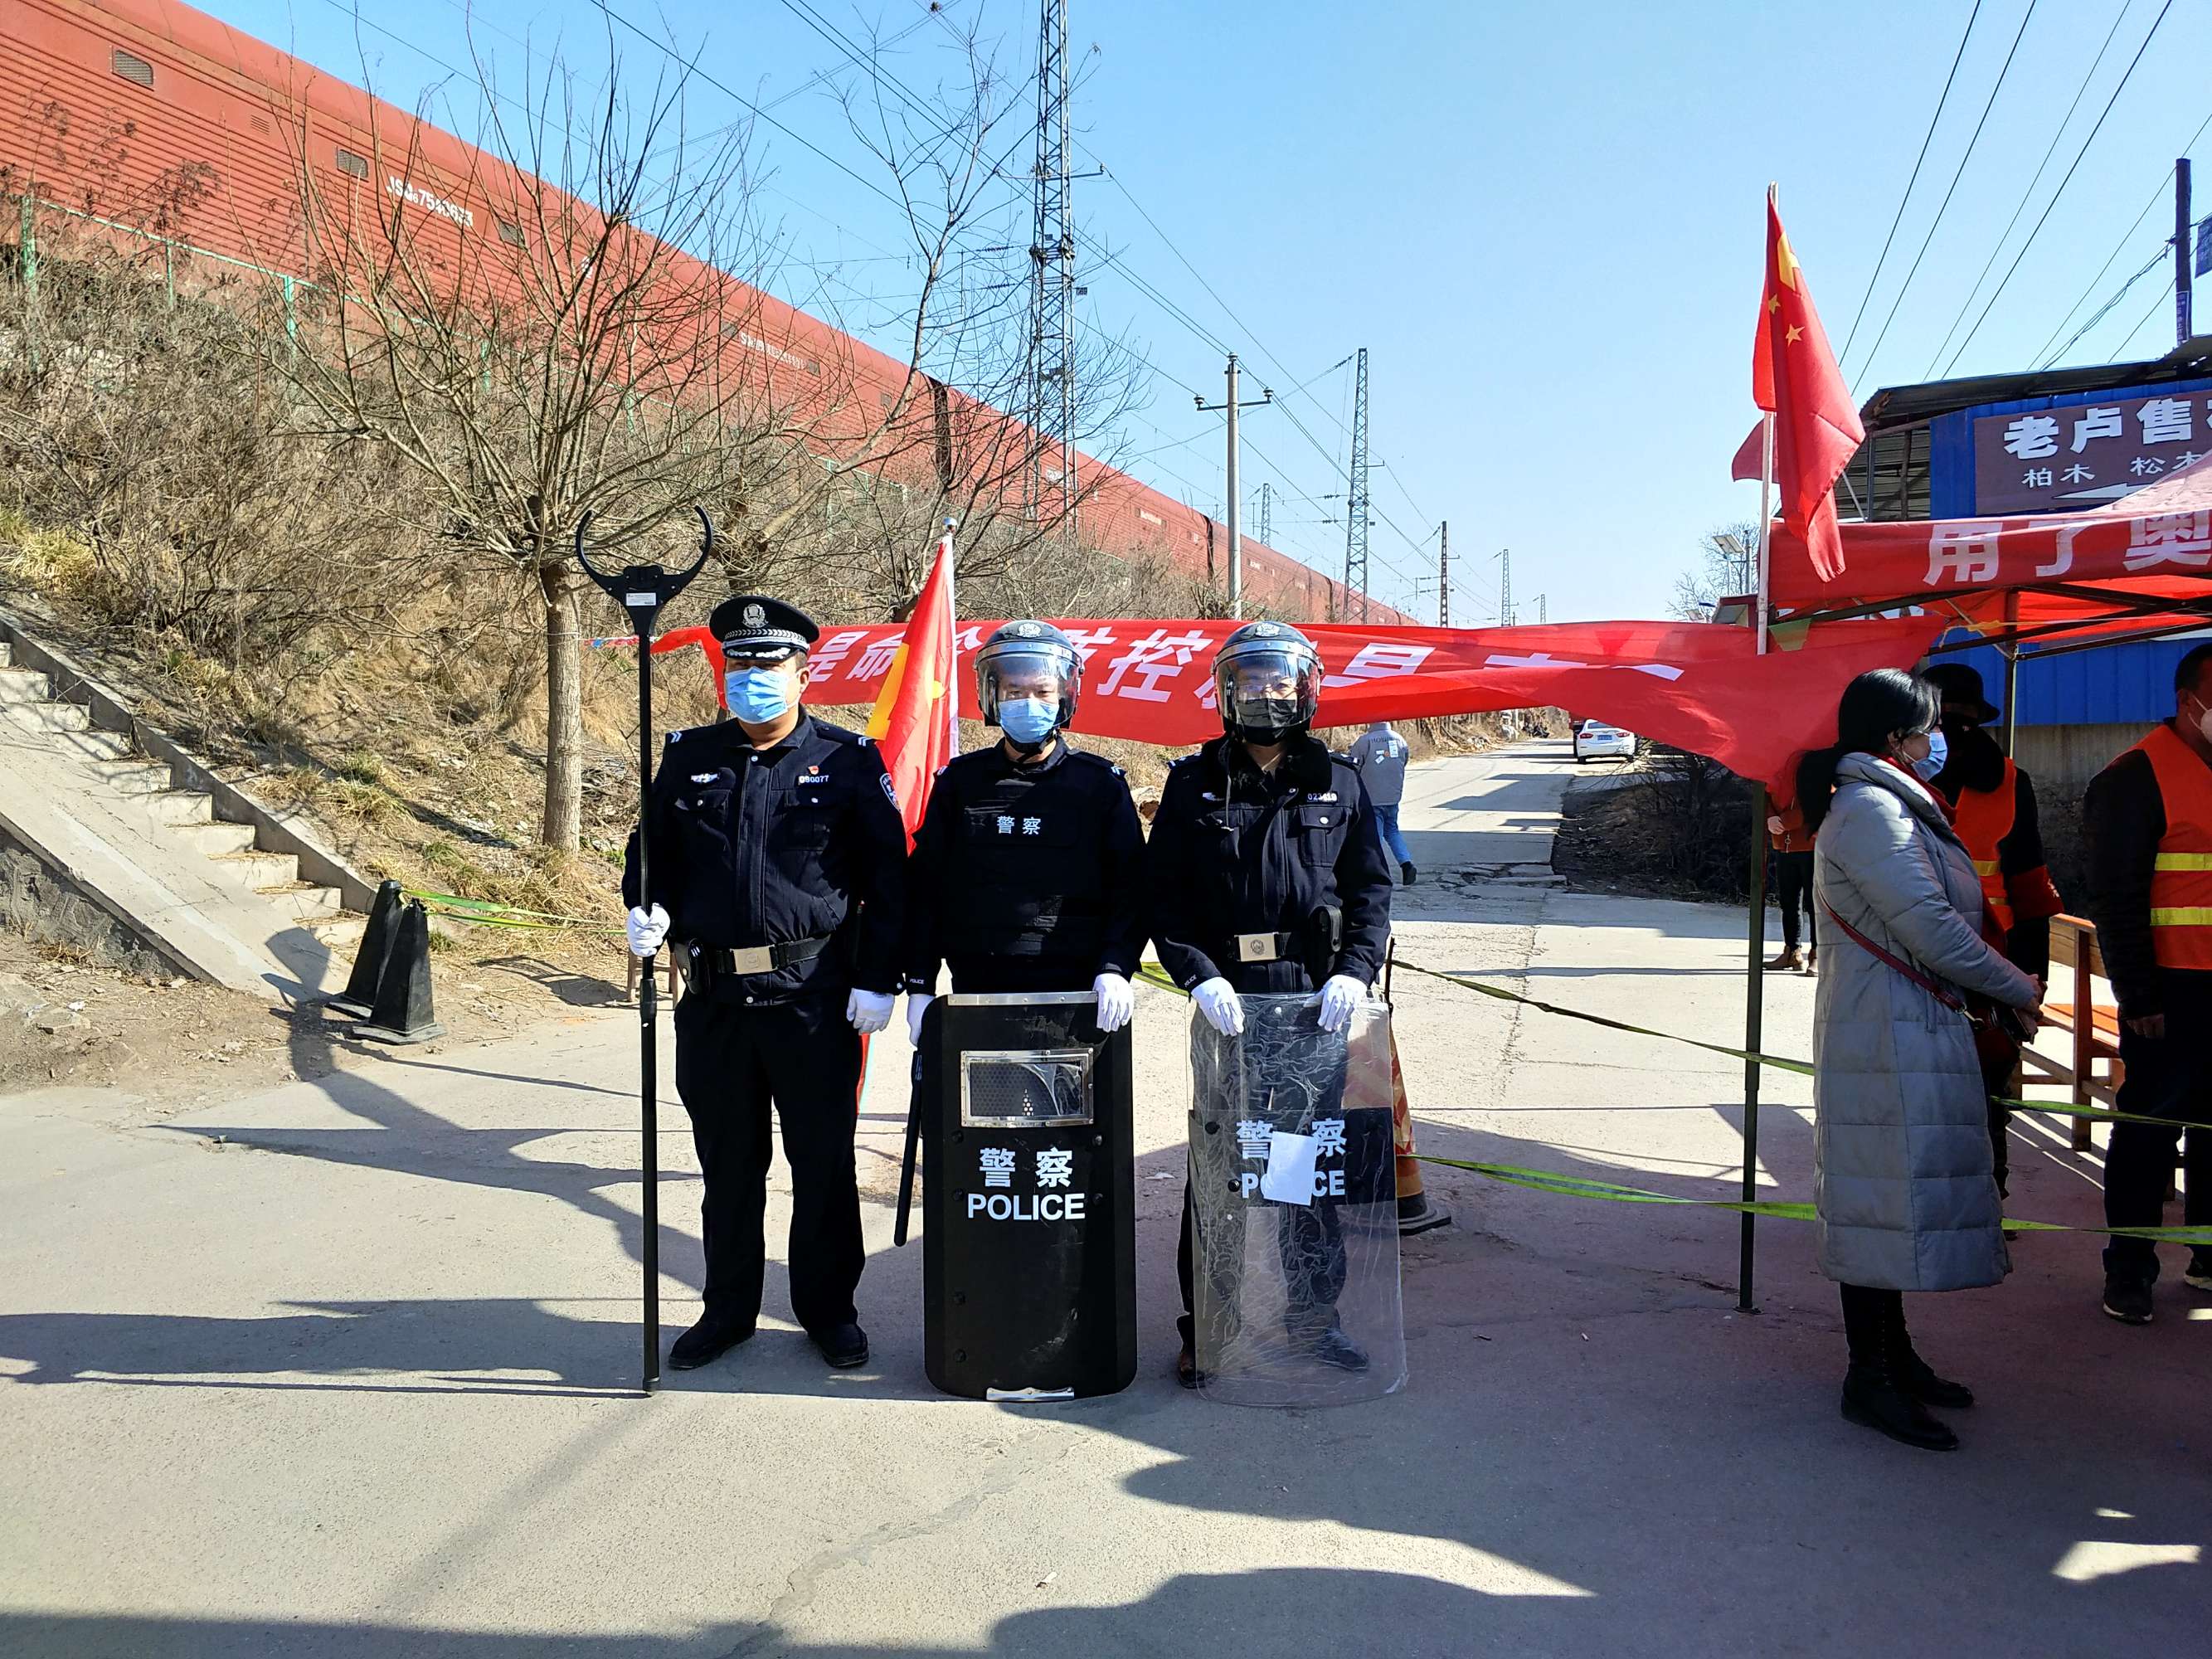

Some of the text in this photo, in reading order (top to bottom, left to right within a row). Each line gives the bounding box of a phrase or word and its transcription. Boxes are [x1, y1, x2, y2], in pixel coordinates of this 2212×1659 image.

[2003, 398, 2212, 460] 老卢售
[2021, 465, 2095, 488] 柏木
[997, 816, 1041, 834] 警察
[1235, 1118, 1347, 1159] 警察
[980, 1146, 1073, 1188] 警察
[1241, 1170, 1345, 1199] PCE
[968, 1193, 1086, 1220] POLICE
